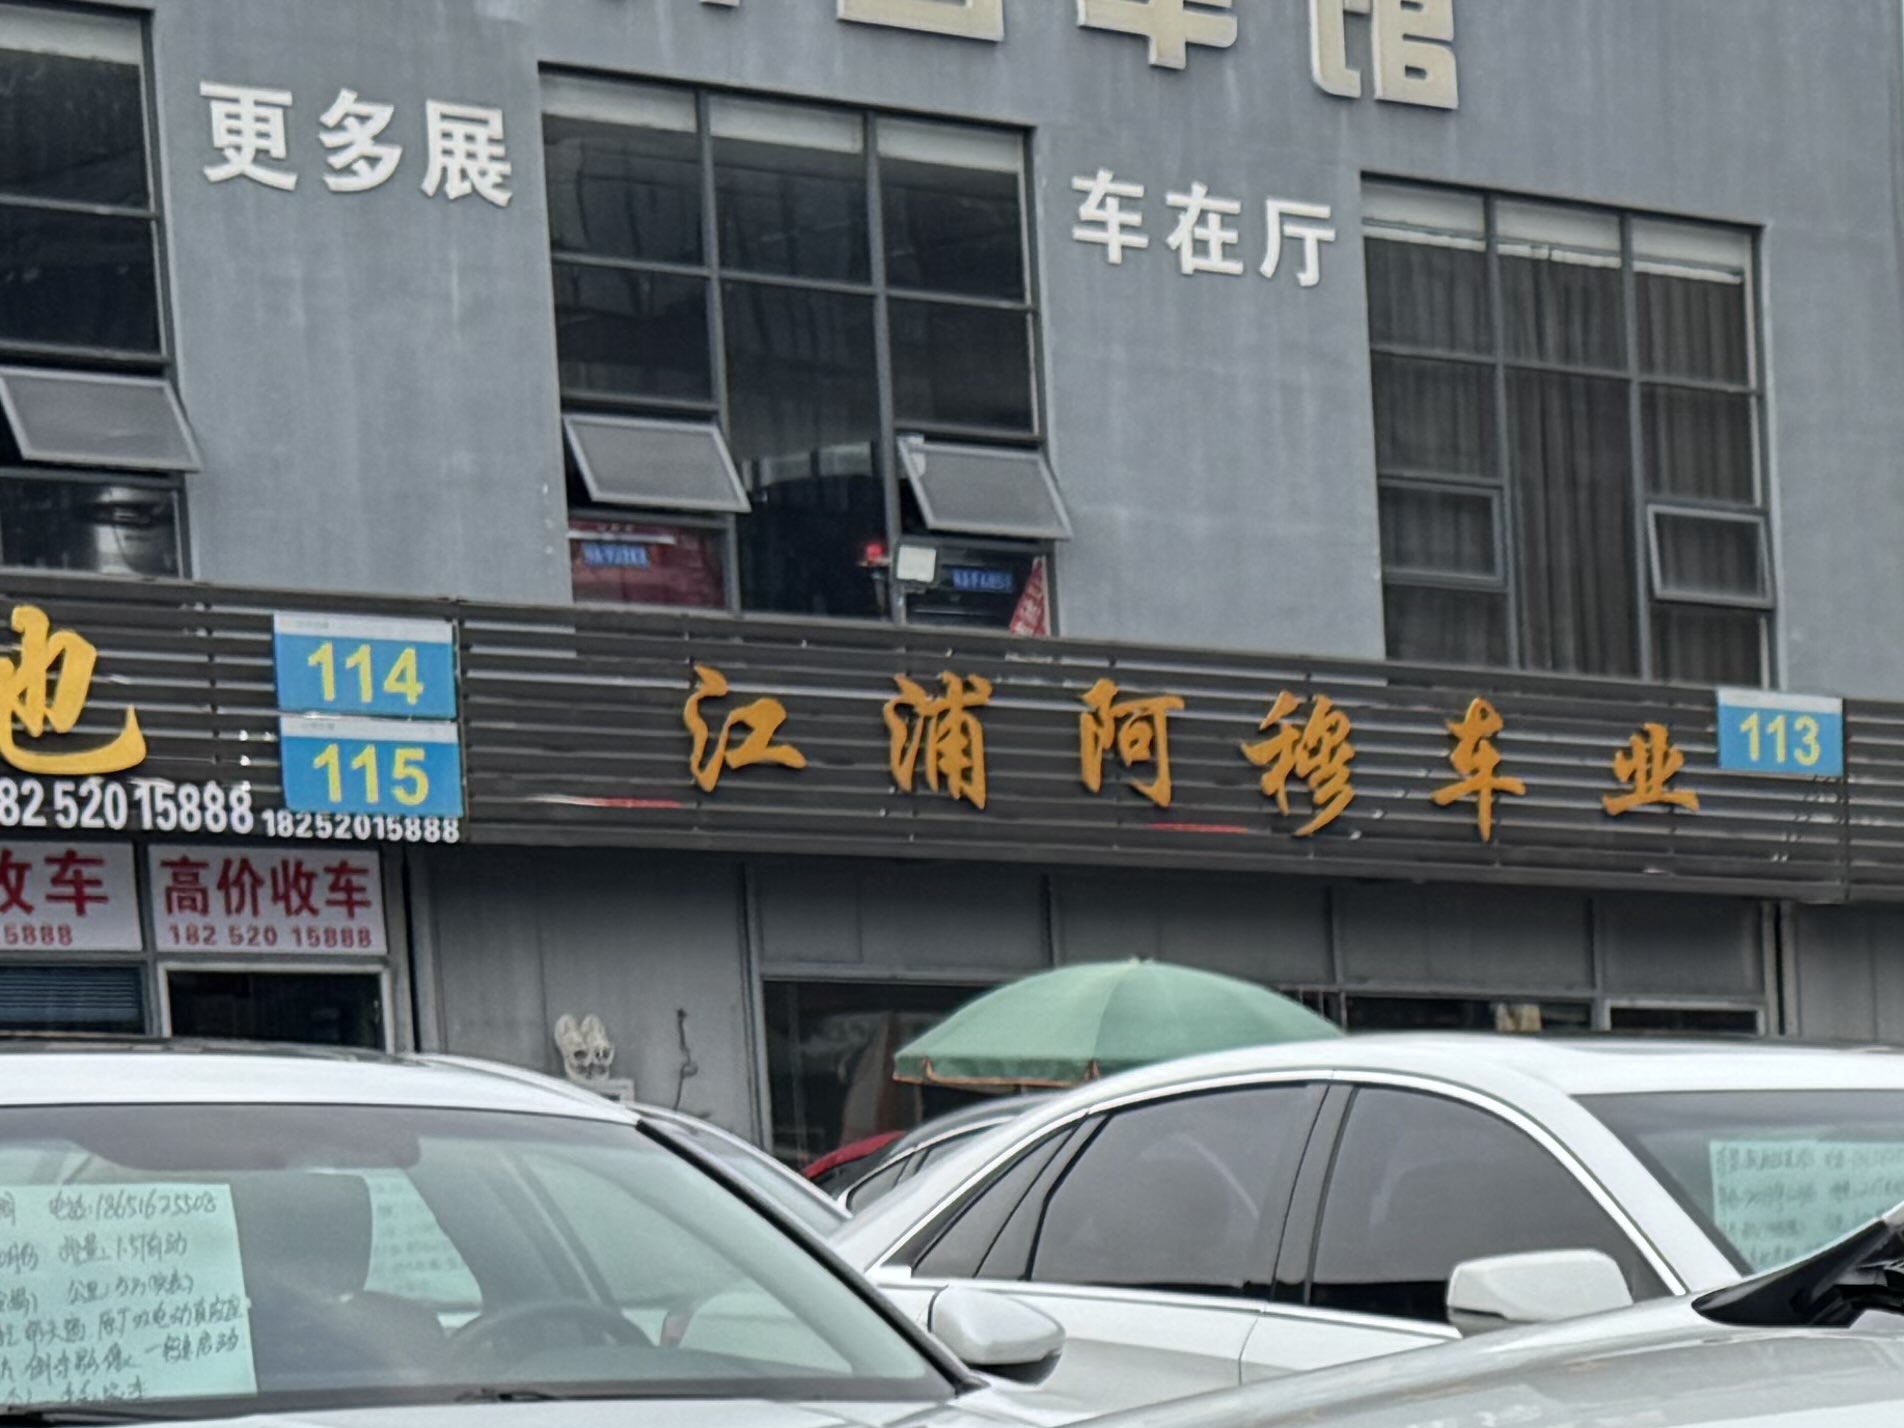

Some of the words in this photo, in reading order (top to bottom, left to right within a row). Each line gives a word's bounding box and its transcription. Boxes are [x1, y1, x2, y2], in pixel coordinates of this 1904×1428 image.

[199, 80, 514, 207] 更多展
[1070, 168, 1337, 287] 车在厅
[307, 640, 424, 705] 114
[682, 663, 1701, 843] 江浦阿穆车业
[1739, 712, 1822, 766] 113
[53, 776, 128, 830] 520
[132, 780, 255, 834] 15888
[312, 742, 429, 806] 115
[261, 807, 460, 844] 18252015888
[159, 854, 374, 921] 高价收车
[169, 924, 217, 946] 182
[228, 925, 279, 947] 520
[292, 926, 372, 949] 15888
